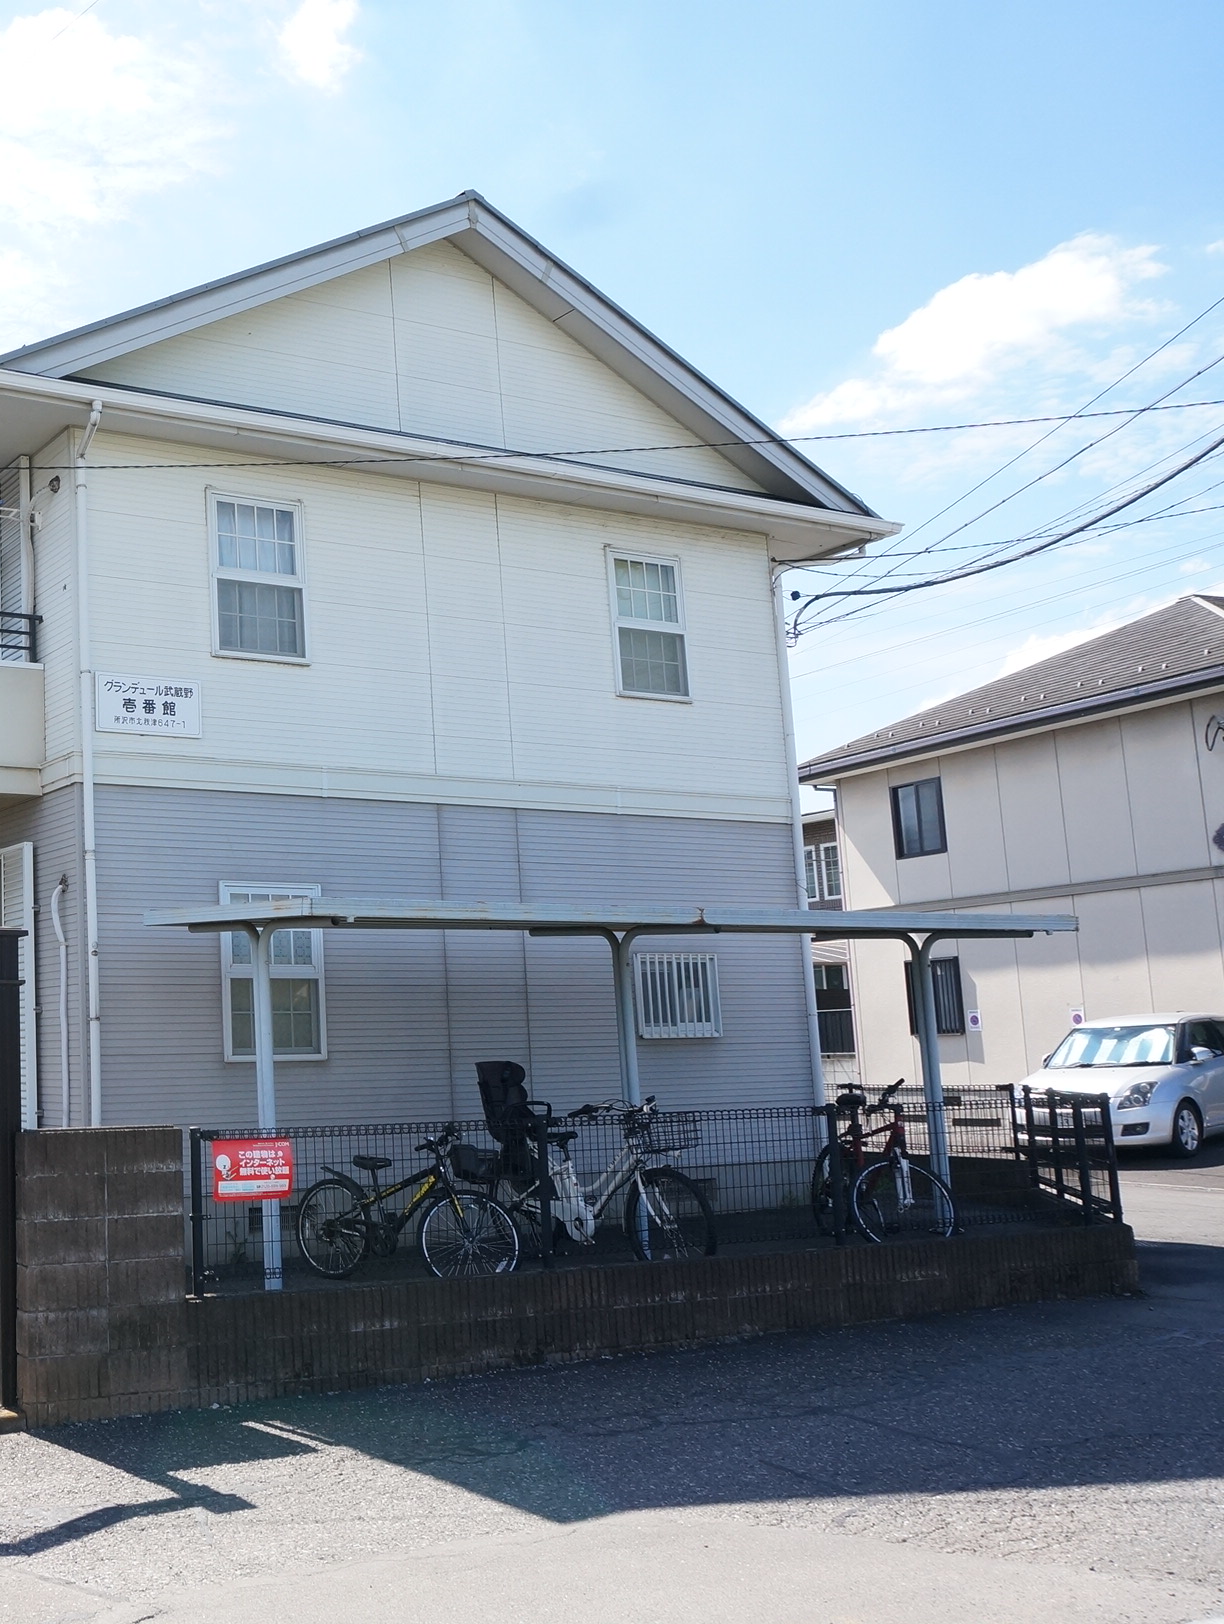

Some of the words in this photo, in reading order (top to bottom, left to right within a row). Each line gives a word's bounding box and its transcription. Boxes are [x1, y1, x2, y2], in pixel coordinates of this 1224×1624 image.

[104, 679, 193, 698] グランデュール武蔵野
[122, 698, 176, 716] 壱番館
[239, 1158, 285, 1167] インターネット
